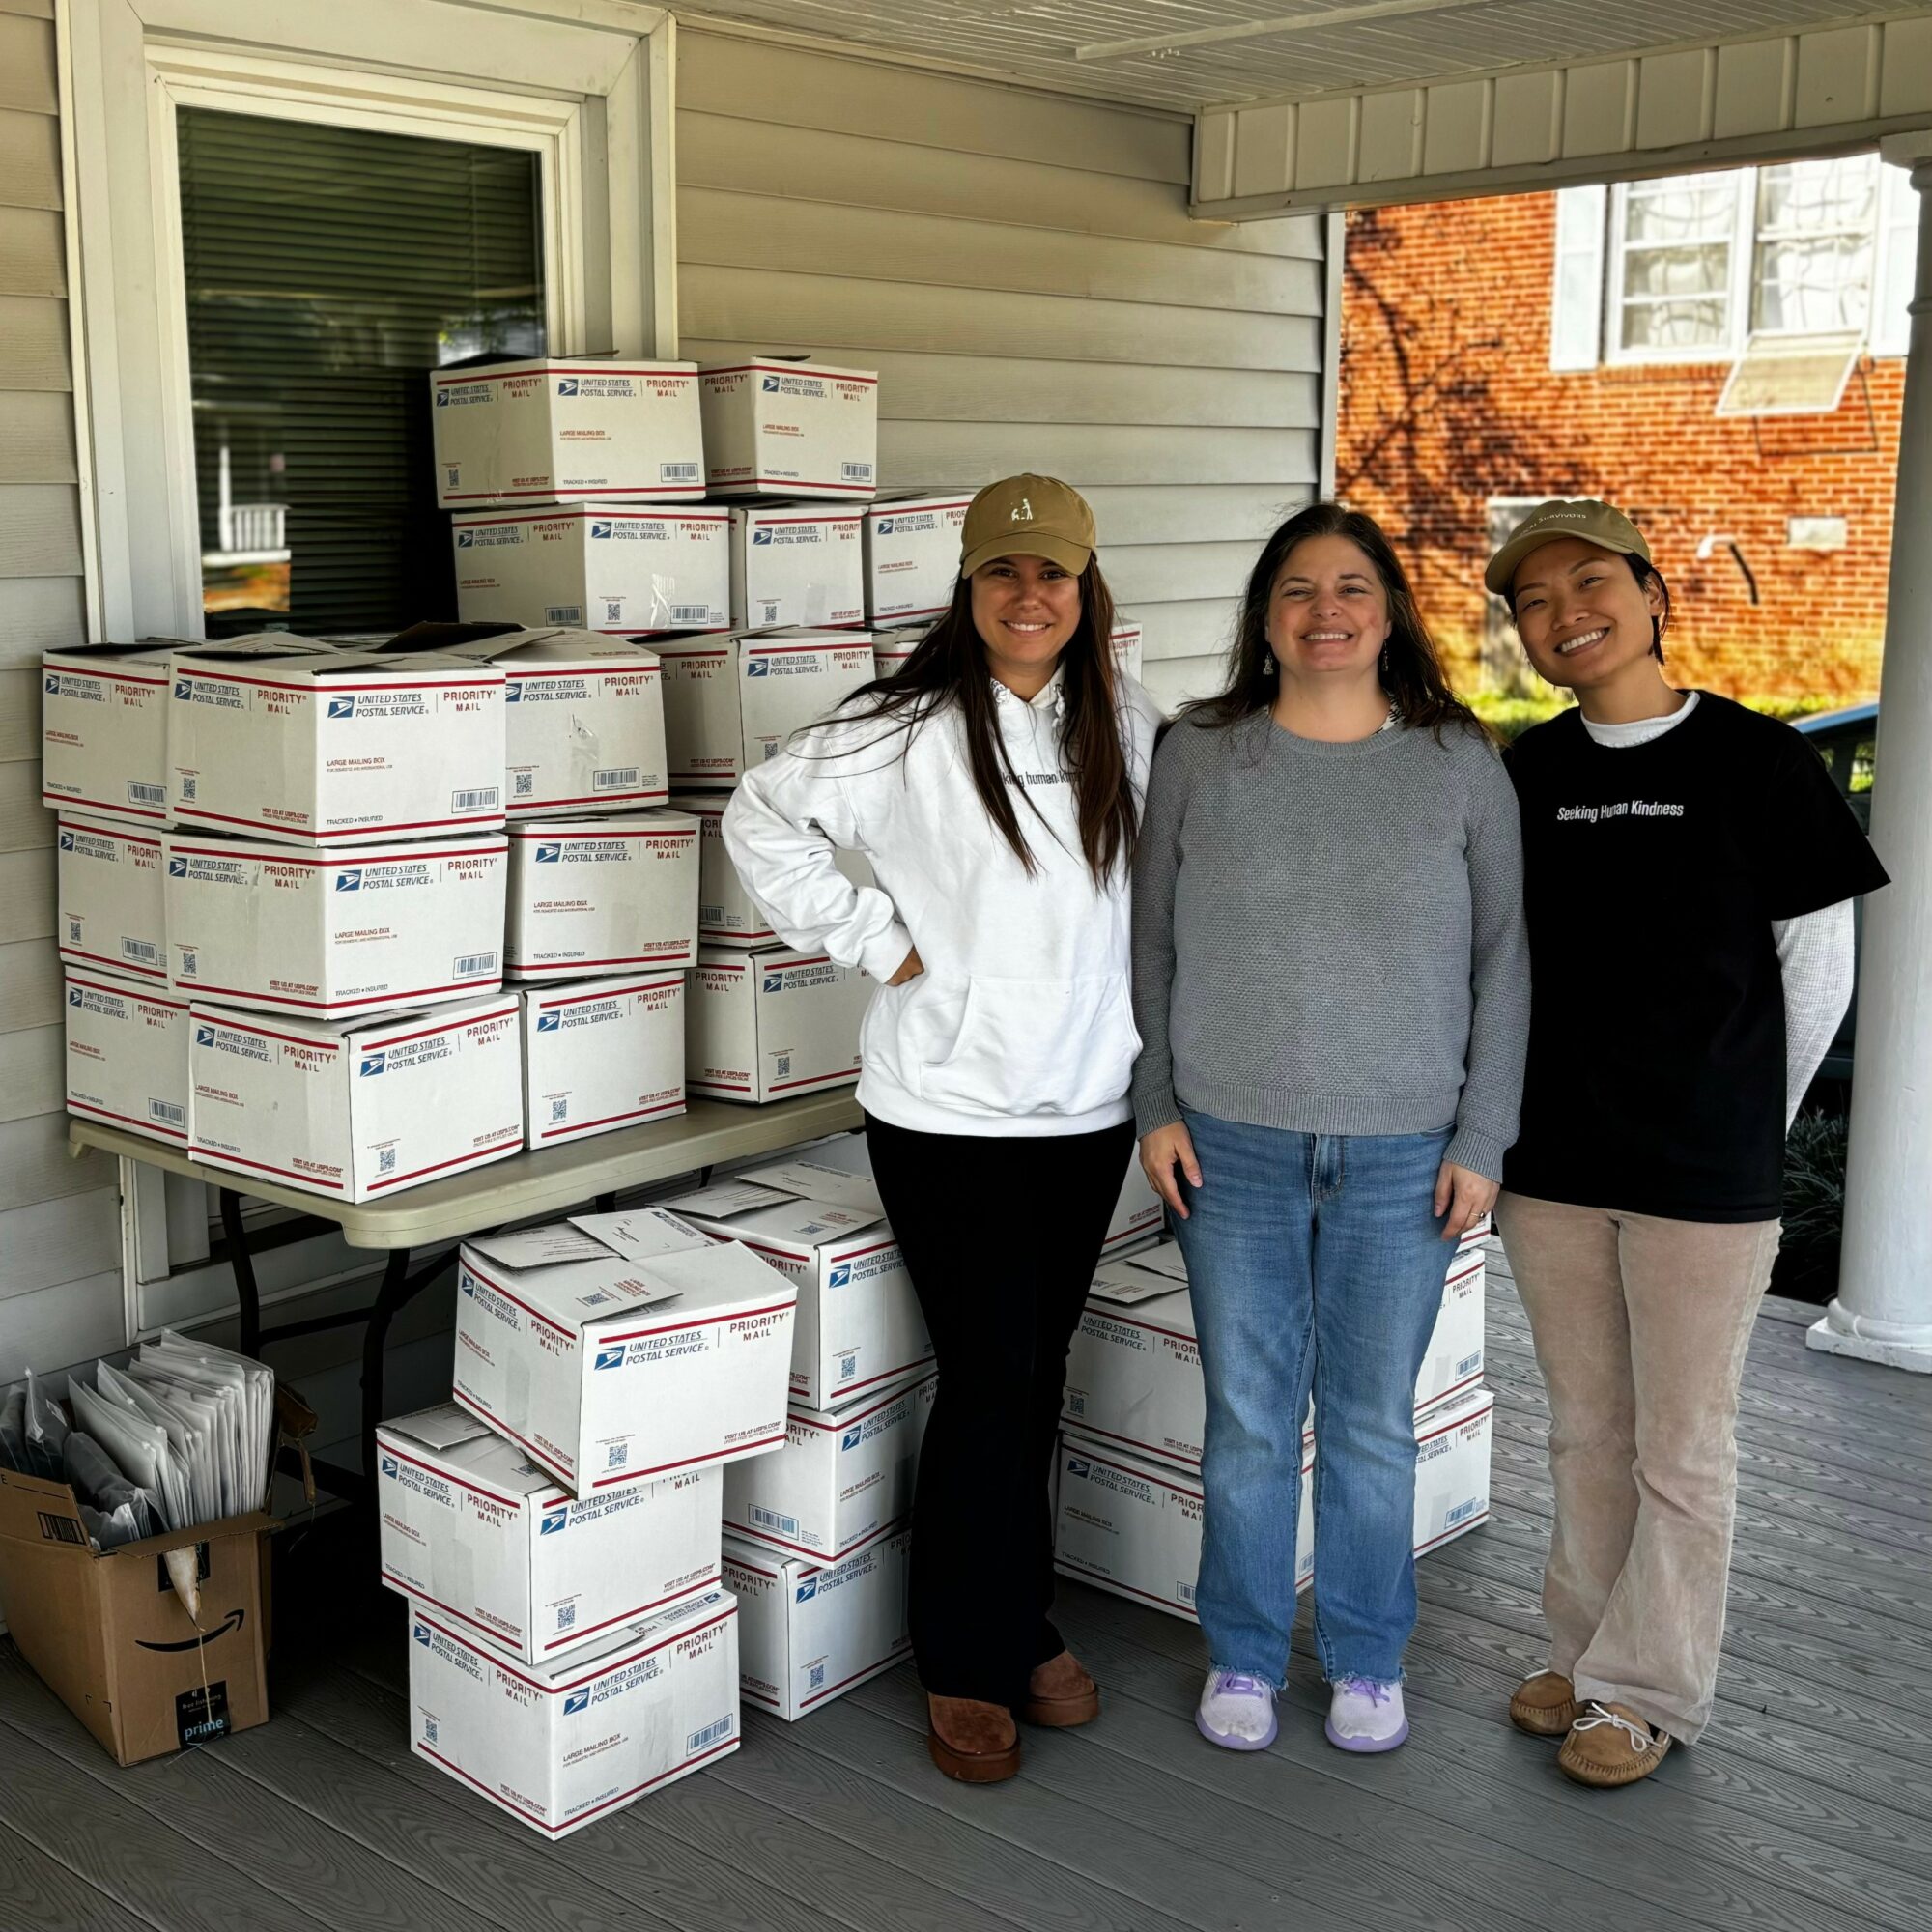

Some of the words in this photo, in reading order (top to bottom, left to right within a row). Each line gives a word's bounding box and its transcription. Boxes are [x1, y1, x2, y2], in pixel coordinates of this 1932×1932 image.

[690, 670, 712, 679] MAIL
[194, 682, 217, 694] UNITED
[218, 686, 240, 696] STATES
[526, 681, 556, 691] UNITED
[558, 680, 584, 689] STATES
[193, 694, 215, 705] POSTAL
[358, 696, 392, 704] UNITED
[393, 694, 422, 703] STATES
[524, 693, 554, 702] POSTAL
[268, 704, 290, 715] MAIL
[356, 708, 388, 718] POSTAL
[456, 703, 481, 712] MAIL
[1556, 805, 1598, 823] Seeking
[1600, 801, 1628, 819] Human
[1631, 800, 1684, 816] Kindness
[565, 842, 597, 851] UNITED
[598, 841, 626, 850] STATES
[190, 860, 217, 870] UNITED
[562, 854, 593, 863] POSTAL
[188, 870, 214, 881] POSTAL
[365, 867, 398, 877] UNITED
[399, 865, 427, 874] STATES
[460, 871, 483, 881] MAIL
[275, 879, 299, 890] MAIL
[363, 879, 394, 890] POSTAL
[785, 969, 810, 980] UNITED
[810, 965, 834, 977] STATES
[706, 982, 729, 992] MAIL
[784, 980, 809, 990] POSTAL
[564, 1005, 592, 1017] UNITED
[593, 1001, 618, 1012] STATES
[647, 1002, 668, 1011] MAIL
[562, 1017, 589, 1029] POSTAL
[217, 1030, 242, 1043] UNITED
[243, 1037, 267, 1049] STATES
[478, 1034, 500, 1046] MAIL
[216, 1041, 241, 1055] POSTAL
[388, 1044, 419, 1059] UNITED
[419, 1037, 445, 1052] STATES
[295, 1061, 319, 1072] MAIL
[387, 1057, 416, 1071] POSTAL
[473, 1293, 494, 1314] POSTAL
[475, 1284, 496, 1305] UNITED
[497, 1297, 517, 1317] STATES
[1082, 1325, 1109, 1340] POSTAL
[1083, 1315, 1112, 1330] UNITED
[1113, 1324, 1141, 1339] STATES
[630, 1338, 668, 1352] UNITED
[668, 1331, 703, 1347] STATES
[744, 1329, 771, 1341] MAIL
[540, 1338, 560, 1356] MAIL
[626, 1351, 663, 1366] POSTAL
[1175, 1352, 1201, 1366] MAIL
[399, 1475, 422, 1493] POSTAL
[400, 1464, 425, 1482] UNITED
[425, 1476, 449, 1493] STATES
[675, 1474, 700, 1490] MAIL
[1090, 1474, 1119, 1491] POSTAL
[1093, 1464, 1122, 1482] UNITED
[1122, 1476, 1151, 1492] STATES
[478, 1511, 501, 1528] MAIL
[569, 1509, 603, 1526] POSTAL
[733, 1580, 758, 1596] MAIL
[433, 1634, 456, 1655] UNITED
[689, 1642, 713, 1660] MAIL
[432, 1645, 454, 1663] POSTAL
[594, 1671, 627, 1692] UNITED
[628, 1658, 657, 1677] STATES
[506, 1689, 528, 1707] MAIL
[591, 1685, 624, 1705] POSTAL
[185, 1719, 224, 1741] prime
